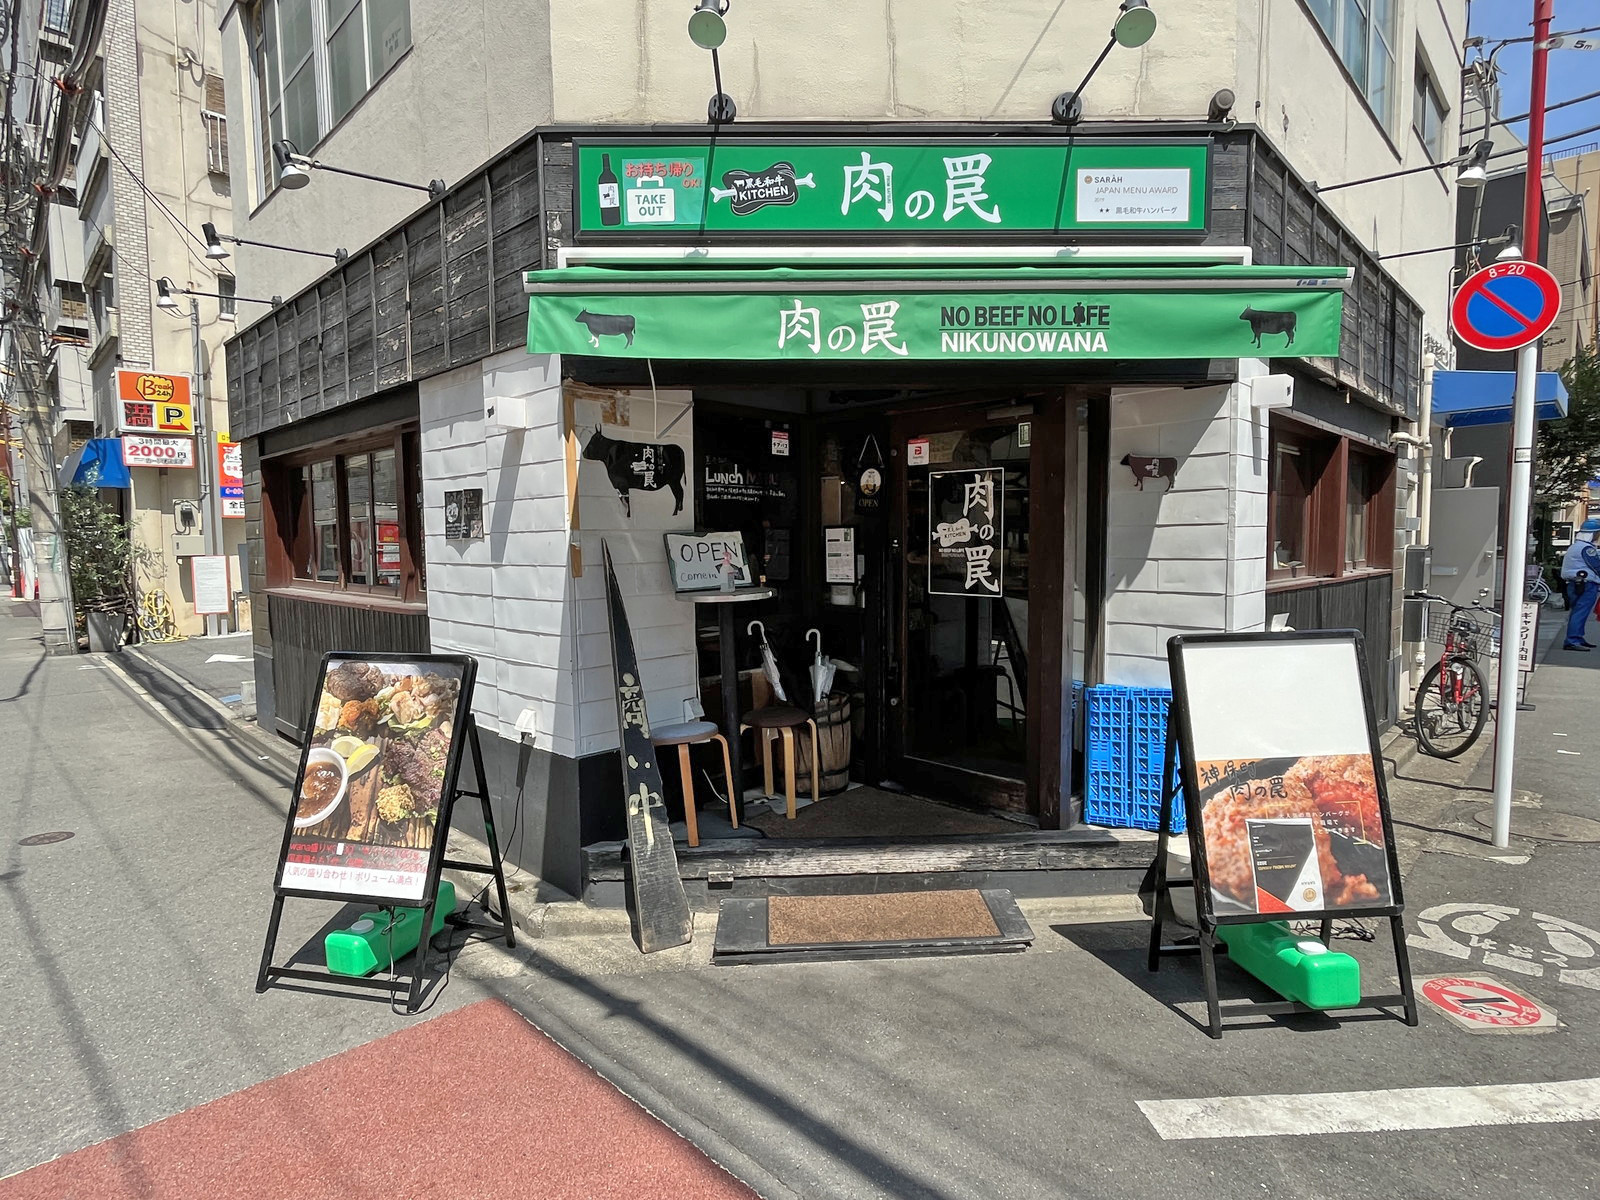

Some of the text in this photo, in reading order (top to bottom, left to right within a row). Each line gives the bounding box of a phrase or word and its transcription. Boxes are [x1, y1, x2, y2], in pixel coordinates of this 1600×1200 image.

[625, 162, 694, 178] お持ち帰り
[682, 179, 702, 188] OK!
[739, 185, 789, 201] KITCHEN
[841, 151, 1002, 223] 肉の罠
[635, 194, 667, 205] TAKE
[638, 206, 663, 216] OUT
[940, 306, 970, 327] NO
[974, 305, 1024, 326] BEEF
[1028, 305, 1058, 326] NO
[777, 299, 909, 356] 肉の罠
[940, 331, 1109, 353] NIKUNOWANA
[156, 389, 171, 397] 24h
[165, 407, 184, 423] P
[963, 473, 1000, 593] 肉の罠
[680, 541, 738, 563] OPEN
[1230, 777, 1288, 802] 肉の罠
